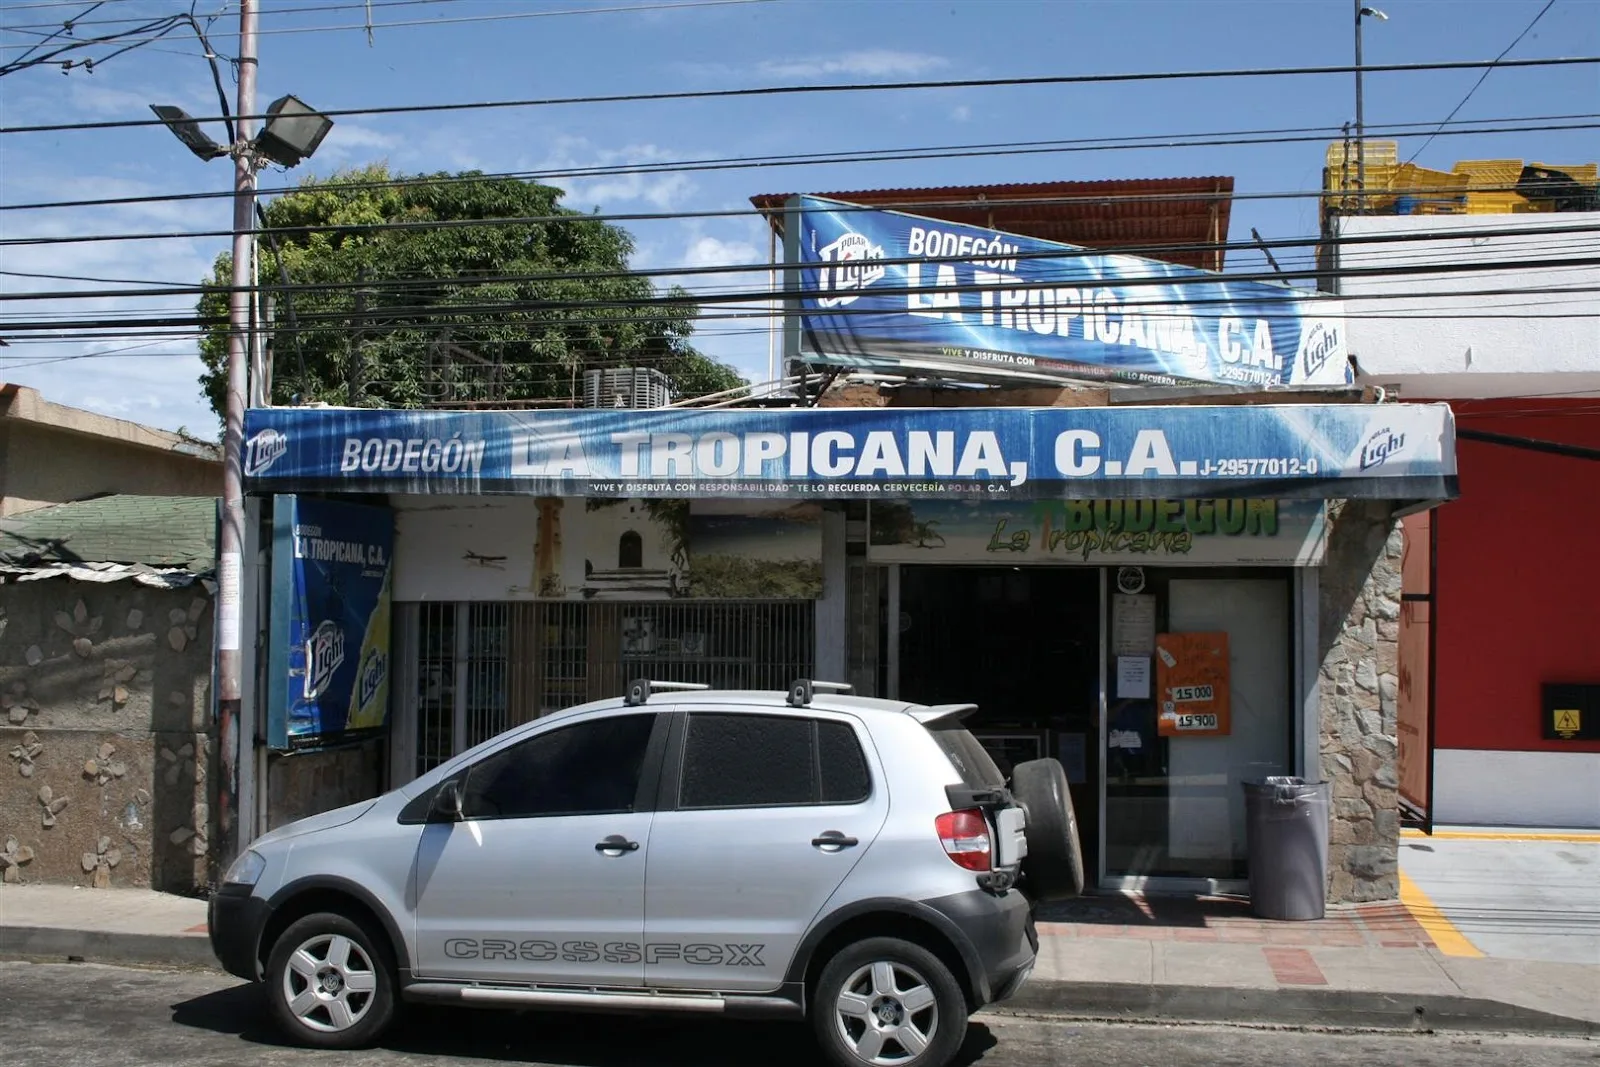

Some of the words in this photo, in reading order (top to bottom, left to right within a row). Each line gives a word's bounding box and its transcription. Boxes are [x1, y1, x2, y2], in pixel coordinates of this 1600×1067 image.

[907, 226, 1019, 272] BODEGÓN
[824, 246, 882, 303] Light
[907, 262, 963, 323] LA
[1218, 312, 1283, 370] C.A.
[1303, 328, 1338, 378] Light
[964, 350, 971, 359] Y
[973, 351, 1015, 364] DISFRUTA
[1016, 356, 1036, 366] CON
[1127, 372, 1138, 381] LO
[1139, 374, 1176, 386] RECUERDA
[248, 437, 287, 475] Light
[340, 432, 487, 473] BODEGÓN
[511, 433, 592, 476] LA
[611, 430, 1029, 487] TROPICANA,
[1054, 429, 1197, 477] C.A.
[1199, 457, 1319, 476] J-29577012-0
[1359, 433, 1406, 472] Light
[617, 483, 624, 492] Y
[626, 483, 672, 492] DISFRUTA
[674, 483, 696, 492] CON
[797, 484, 809, 492] TE
[812, 484, 825, 492] LO
[828, 483, 881, 493] RECUERDA
[883, 481, 946, 492] CERVECERÍA
[987, 484, 1008, 493] C.A.
[295, 536, 309, 559] LA
[310, 538, 367, 568] TROPICANA,
[368, 545, 386, 566] C.A.
[987, 518, 1031, 553] La
[307, 628, 344, 693] Light
[359, 653, 387, 713] Light
[443, 938, 766, 967] CROSSFOX
